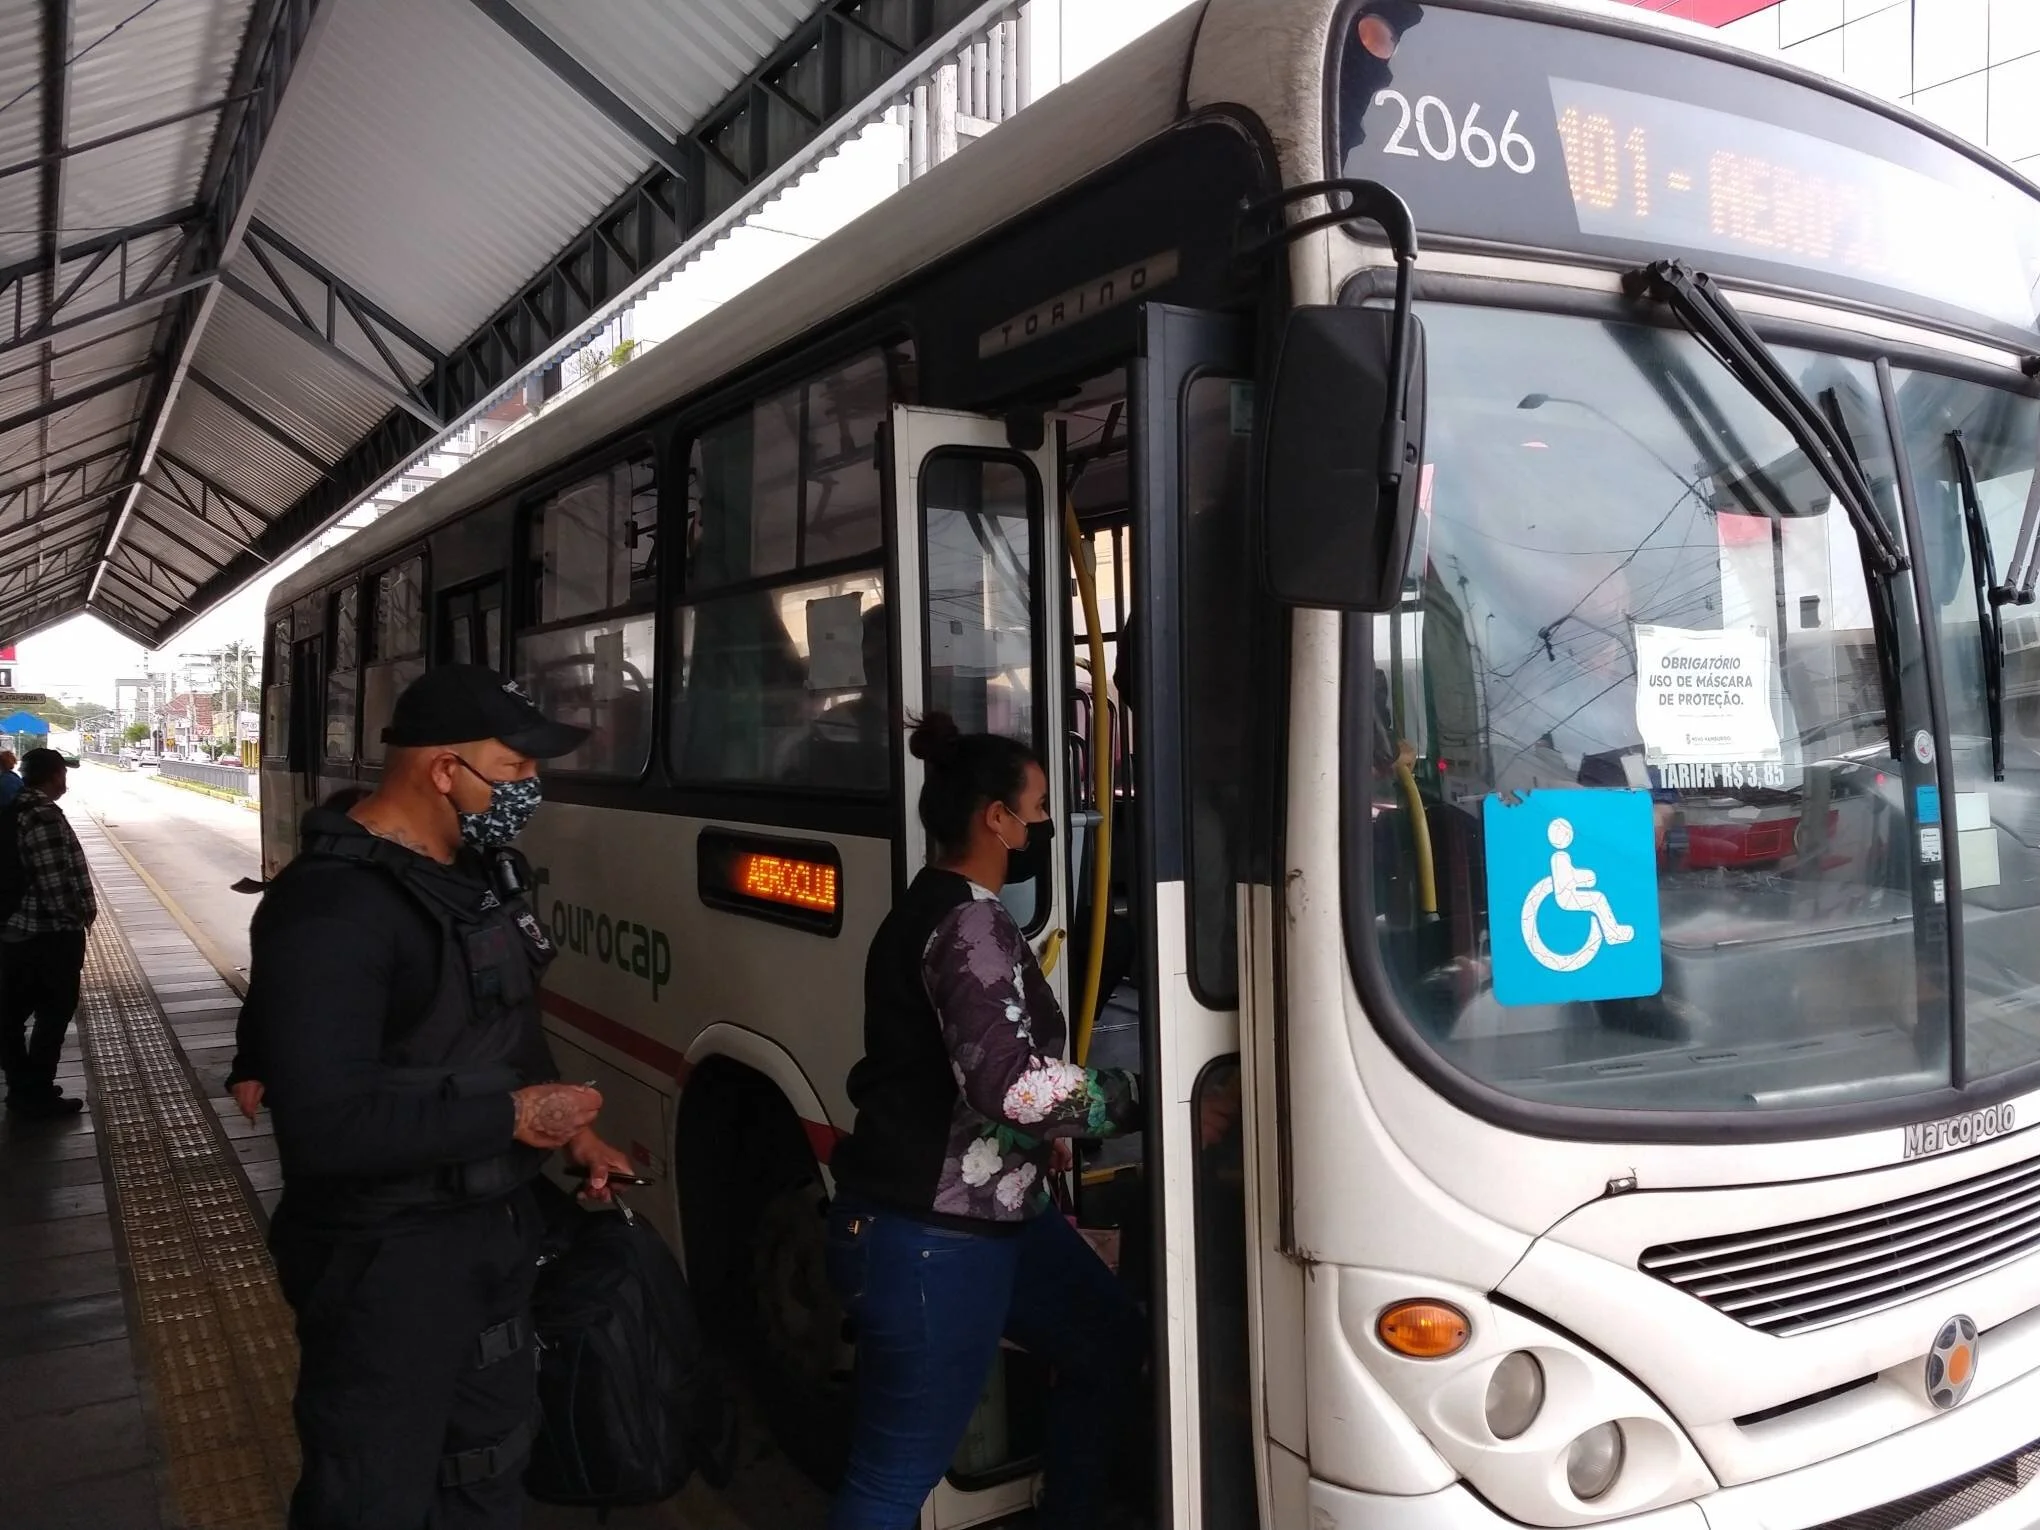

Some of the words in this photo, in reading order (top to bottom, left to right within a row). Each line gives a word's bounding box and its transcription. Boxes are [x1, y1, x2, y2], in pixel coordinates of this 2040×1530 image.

[1374, 89, 1536, 175] 2066
[1002, 267, 1146, 344] TORINO
[1661, 655, 1741, 670] OBRIGATÓRIO
[1649, 674, 1672, 688] USO
[1677, 675, 1693, 688] DE
[1696, 672, 1753, 688] MÁSCARA
[1658, 693, 1674, 706] DE
[1678, 691, 1744, 709] PROTEÇÃO.
[1721, 762, 1744, 790] R$
[1903, 1103, 2016, 1159] Marcopolo
